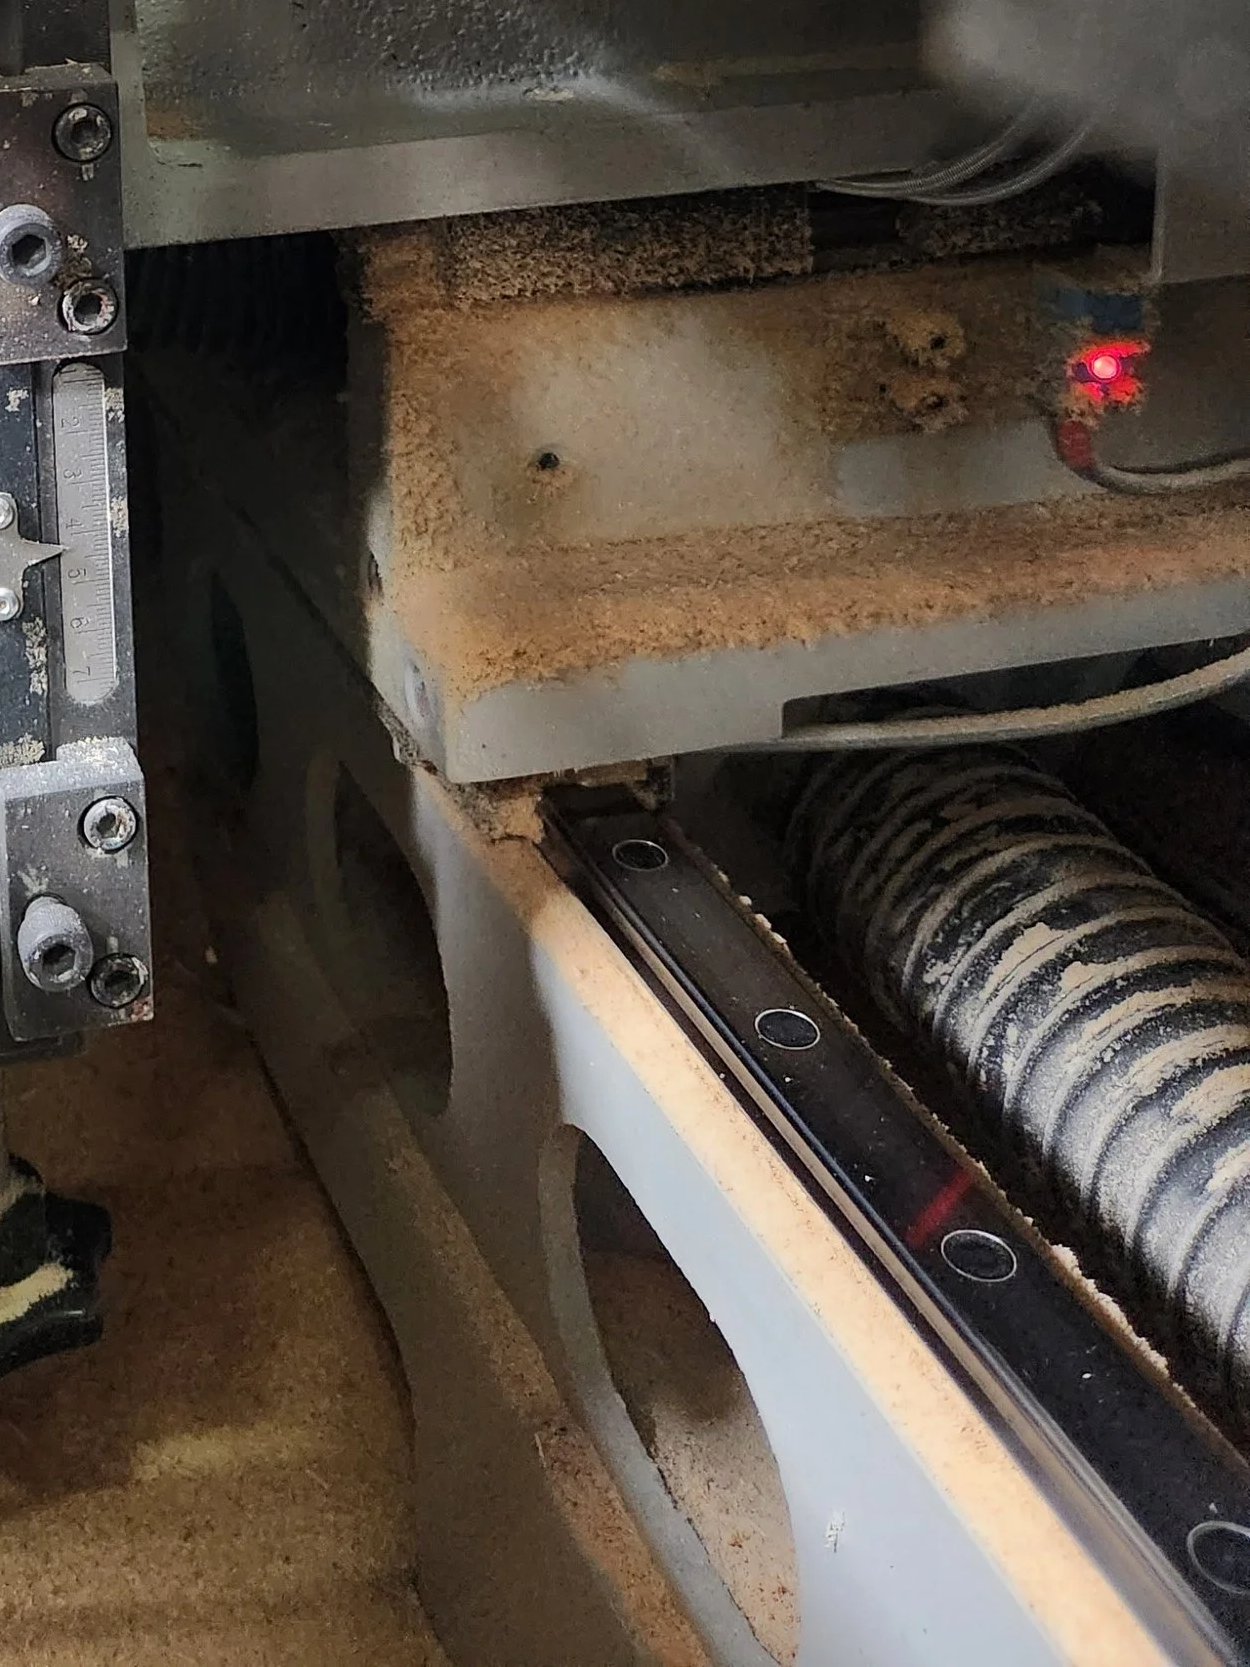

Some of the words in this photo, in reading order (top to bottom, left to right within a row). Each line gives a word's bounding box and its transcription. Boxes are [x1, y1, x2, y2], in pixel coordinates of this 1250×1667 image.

[60, 416, 80, 429] 2
[62, 468, 83, 480] 3
[65, 517, 83, 530] 4
[67, 568, 87, 579] 5
[69, 616, 90, 629] 6
[72, 665, 91, 677] 7
